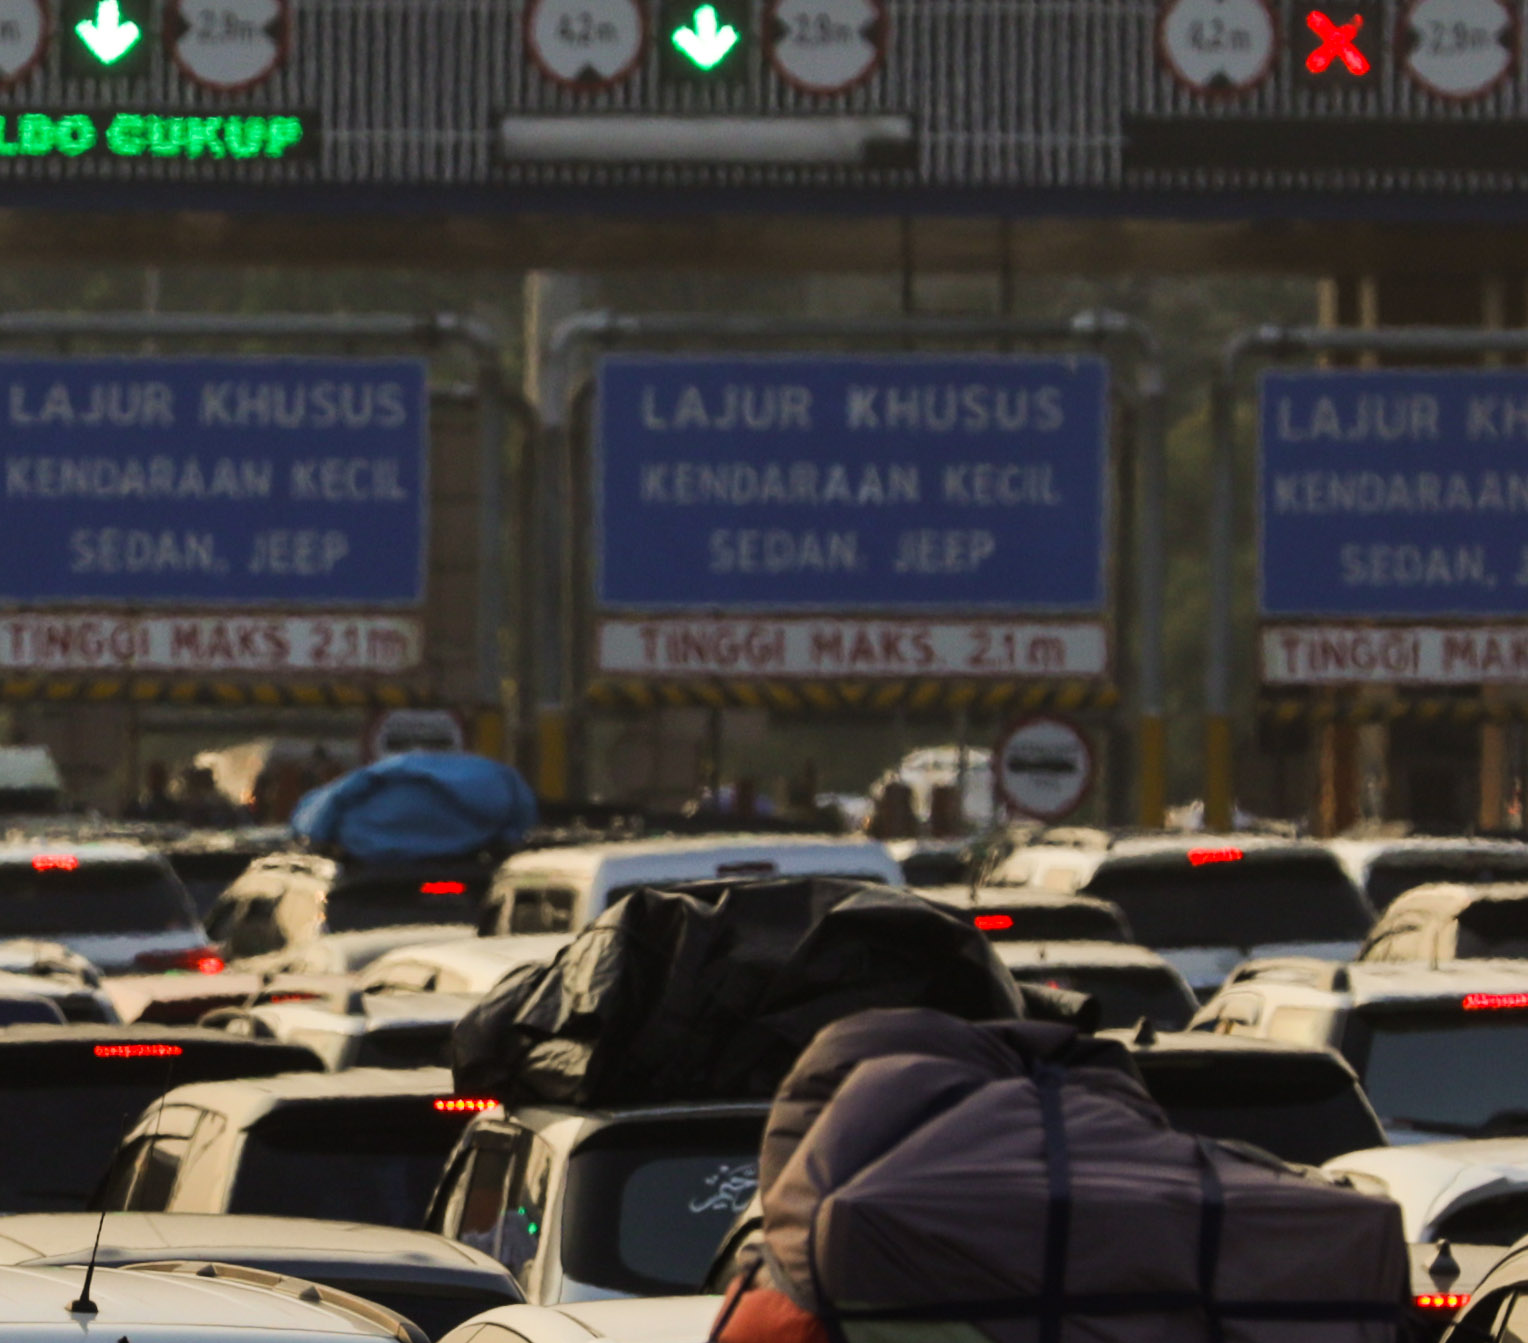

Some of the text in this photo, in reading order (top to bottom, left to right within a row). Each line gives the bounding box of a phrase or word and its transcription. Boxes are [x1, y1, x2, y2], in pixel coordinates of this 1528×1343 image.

[105, 113, 303, 159] CUKUP
[9, 380, 407, 429] LAJUR KHUSUS
[642, 383, 1064, 431] LAJUR KHUSUS
[1275, 394, 1440, 443] LAJUR
[3, 456, 408, 502] KENDARAAN KECIL
[644, 461, 1062, 506] KENDARAAN KECIL
[248, 531, 348, 576] JEEP
[894, 529, 996, 576] JEEP
